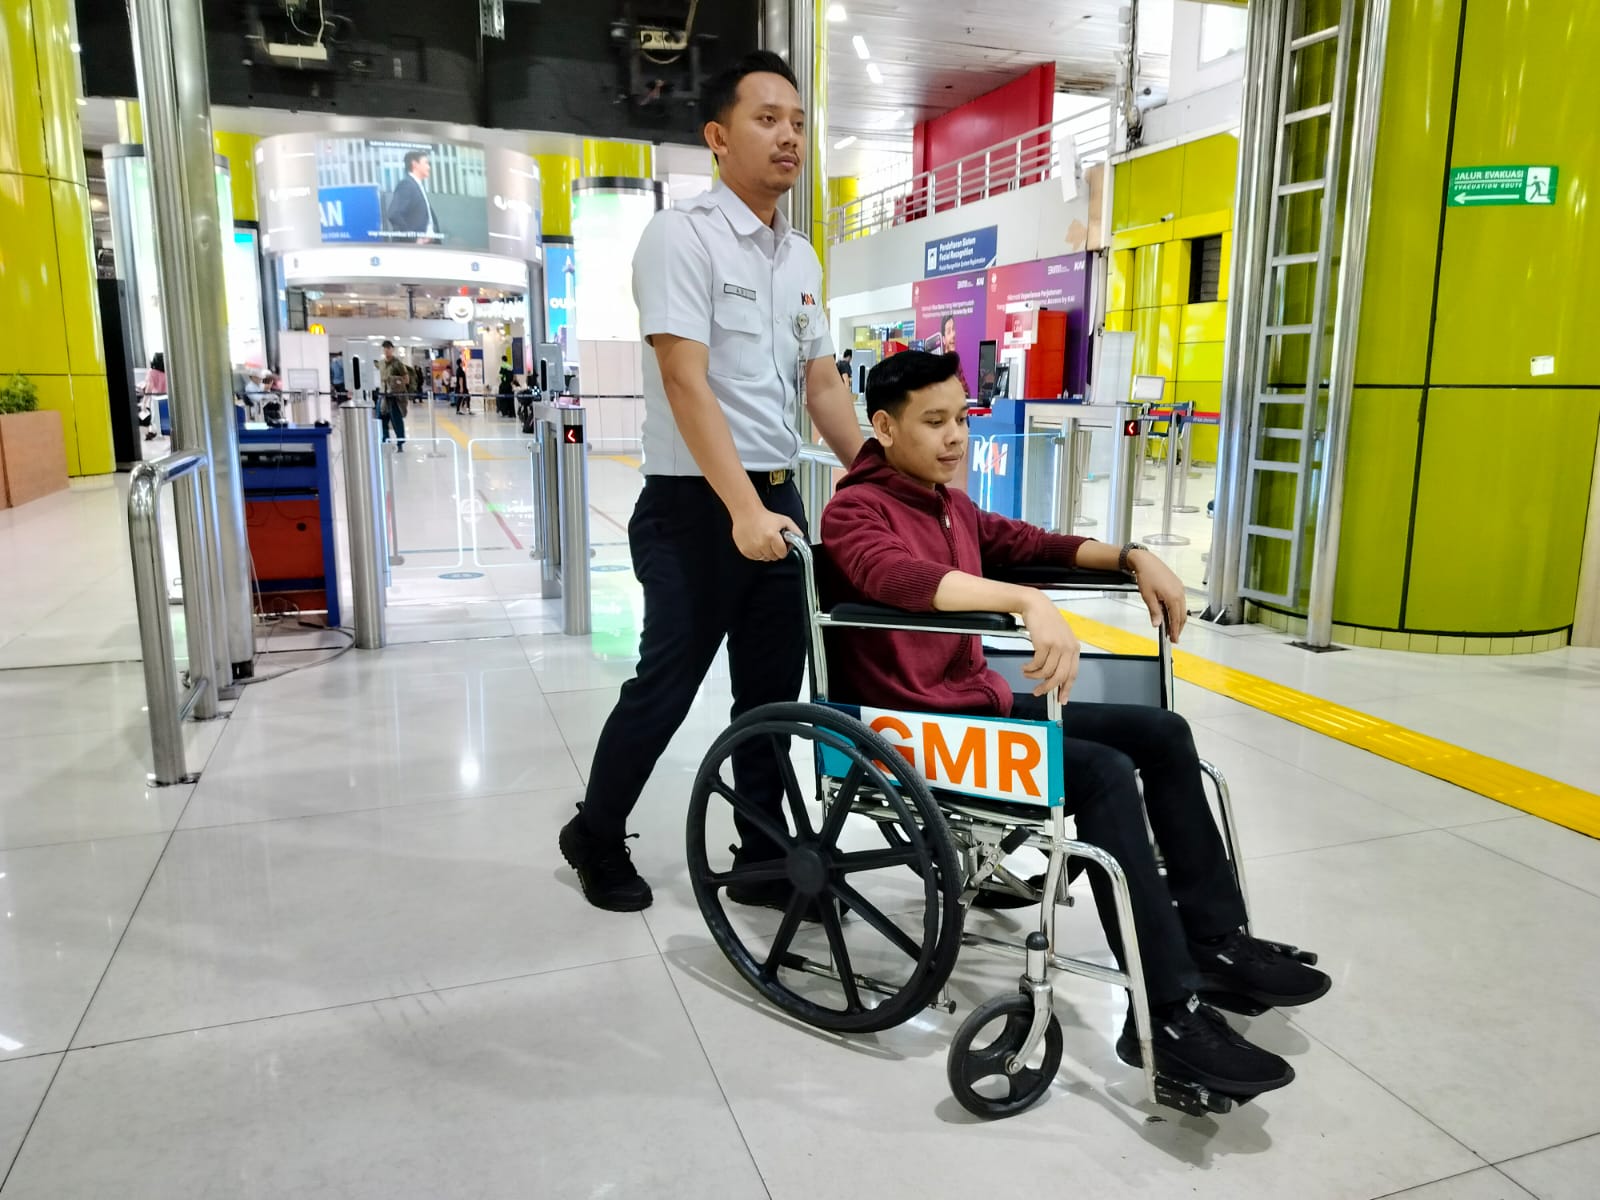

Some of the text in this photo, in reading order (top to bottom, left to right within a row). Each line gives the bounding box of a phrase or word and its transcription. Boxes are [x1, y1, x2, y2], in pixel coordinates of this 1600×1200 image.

[1455, 170, 1524, 181] JALUR EVAKUASI
[1454, 183, 1498, 191] EVACUATION
[940, 241, 963, 252] Pendaftaran
[950, 247, 974, 260] Recognition
[972, 440, 1009, 477] KAI
[870, 715, 1042, 798] GMR
